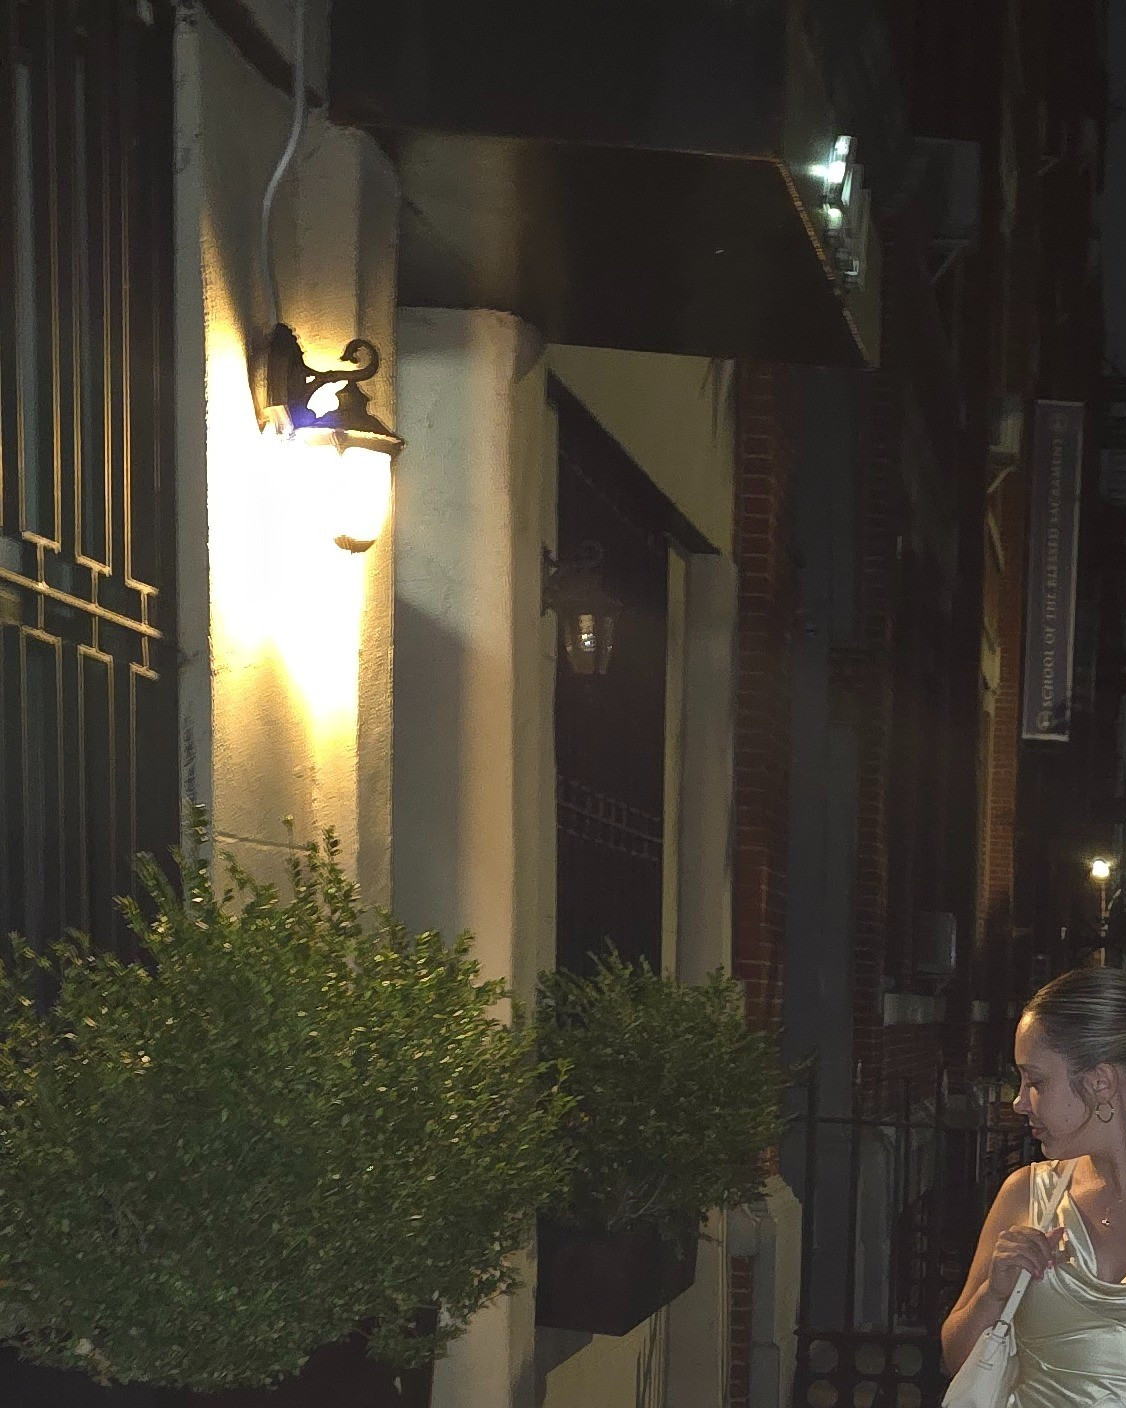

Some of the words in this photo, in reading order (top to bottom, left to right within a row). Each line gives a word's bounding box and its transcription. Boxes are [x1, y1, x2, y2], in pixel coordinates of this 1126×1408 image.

[1043, 592, 1058, 620] THE
[1042, 626, 1056, 645] OF
[1041, 650, 1055, 707] SCHOOL
